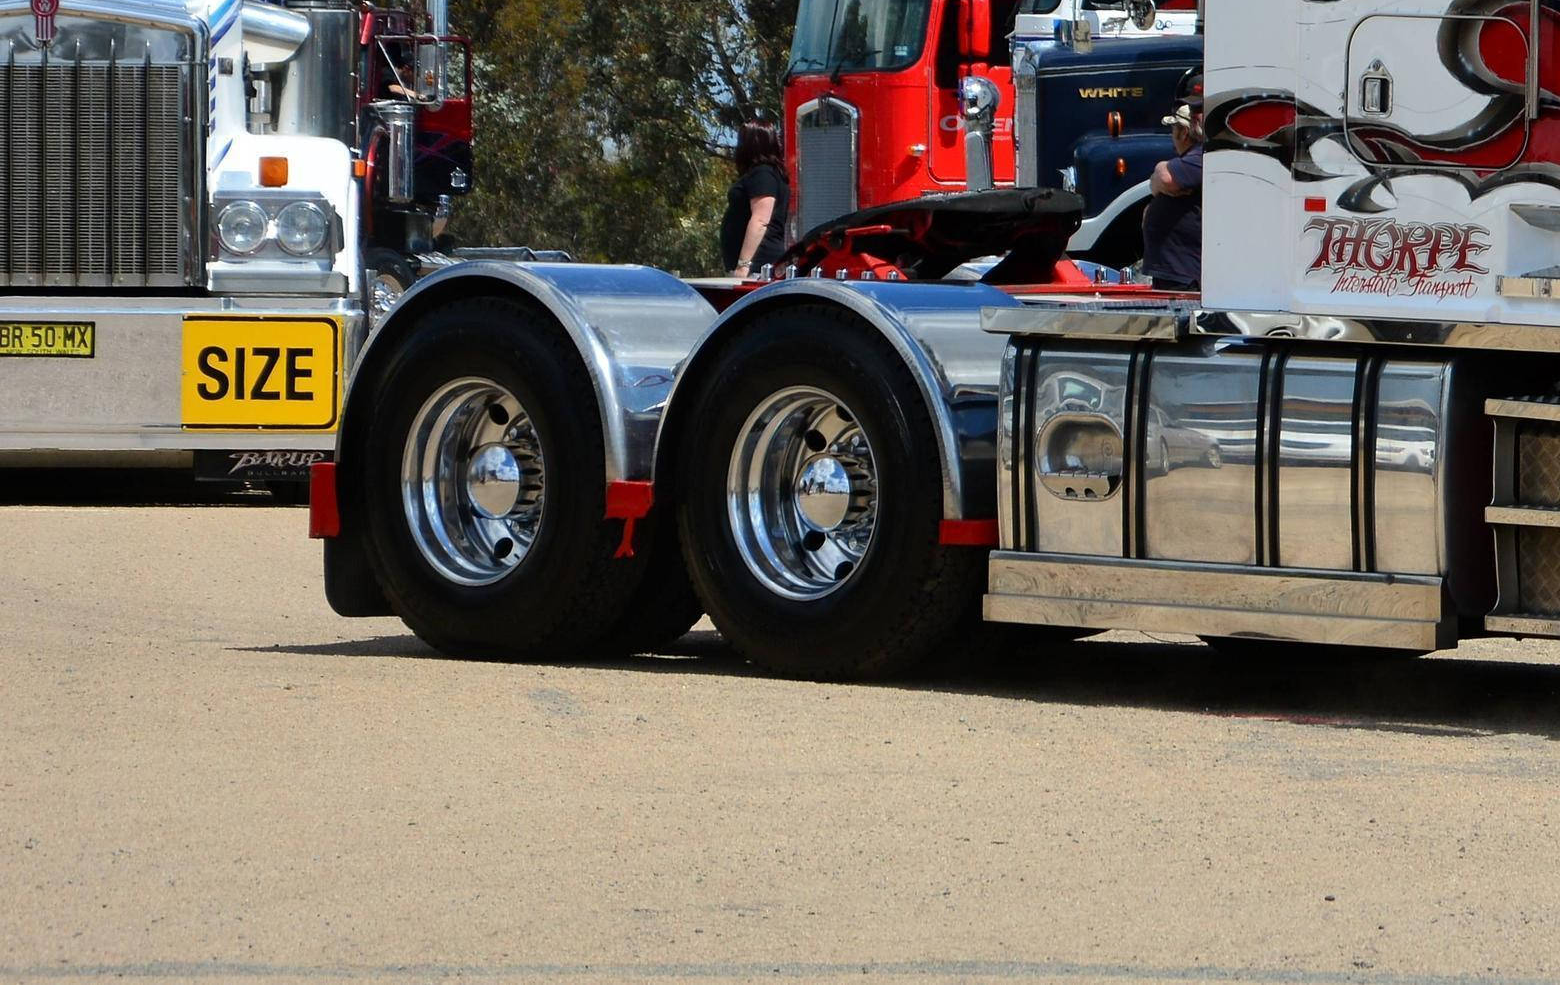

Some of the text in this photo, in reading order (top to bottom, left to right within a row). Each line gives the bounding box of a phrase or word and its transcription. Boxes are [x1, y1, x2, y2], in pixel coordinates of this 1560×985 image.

[1079, 87, 1144, 98] WHITE
[1303, 216, 1492, 279] THORPE
[1331, 267, 1478, 303] Interstate Transport
[197, 346, 314, 401] SIZE
